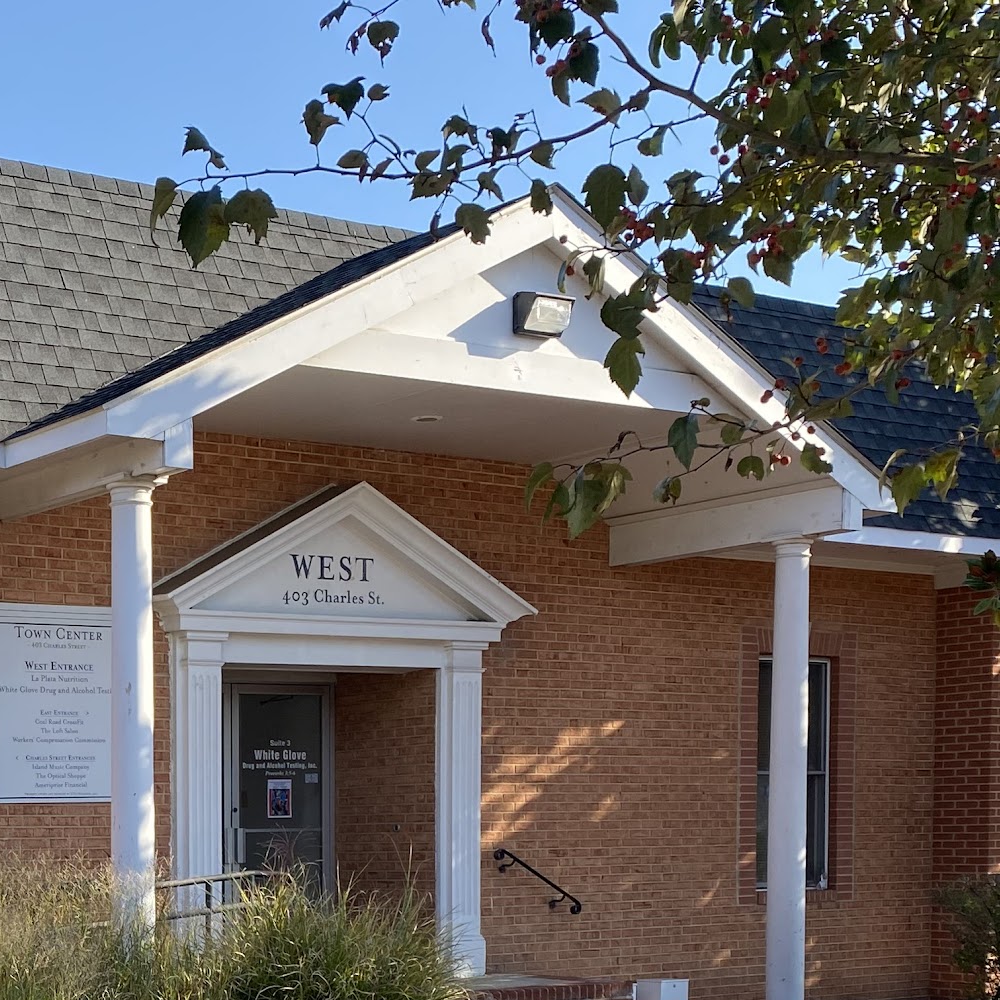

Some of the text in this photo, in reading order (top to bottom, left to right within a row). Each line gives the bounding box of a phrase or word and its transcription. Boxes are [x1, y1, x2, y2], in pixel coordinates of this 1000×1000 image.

[289, 553, 374, 582] WEST
[282, 588, 385, 606] 403 Charles St.
[20, 686, 38, 694] Glove
[40, 686, 56, 696] Drug
[71, 687, 96, 695] Alcohol
[269, 739, 286, 747] Suite
[253, 749, 307, 760] White Glove
[242, 762, 255, 770] Drug
